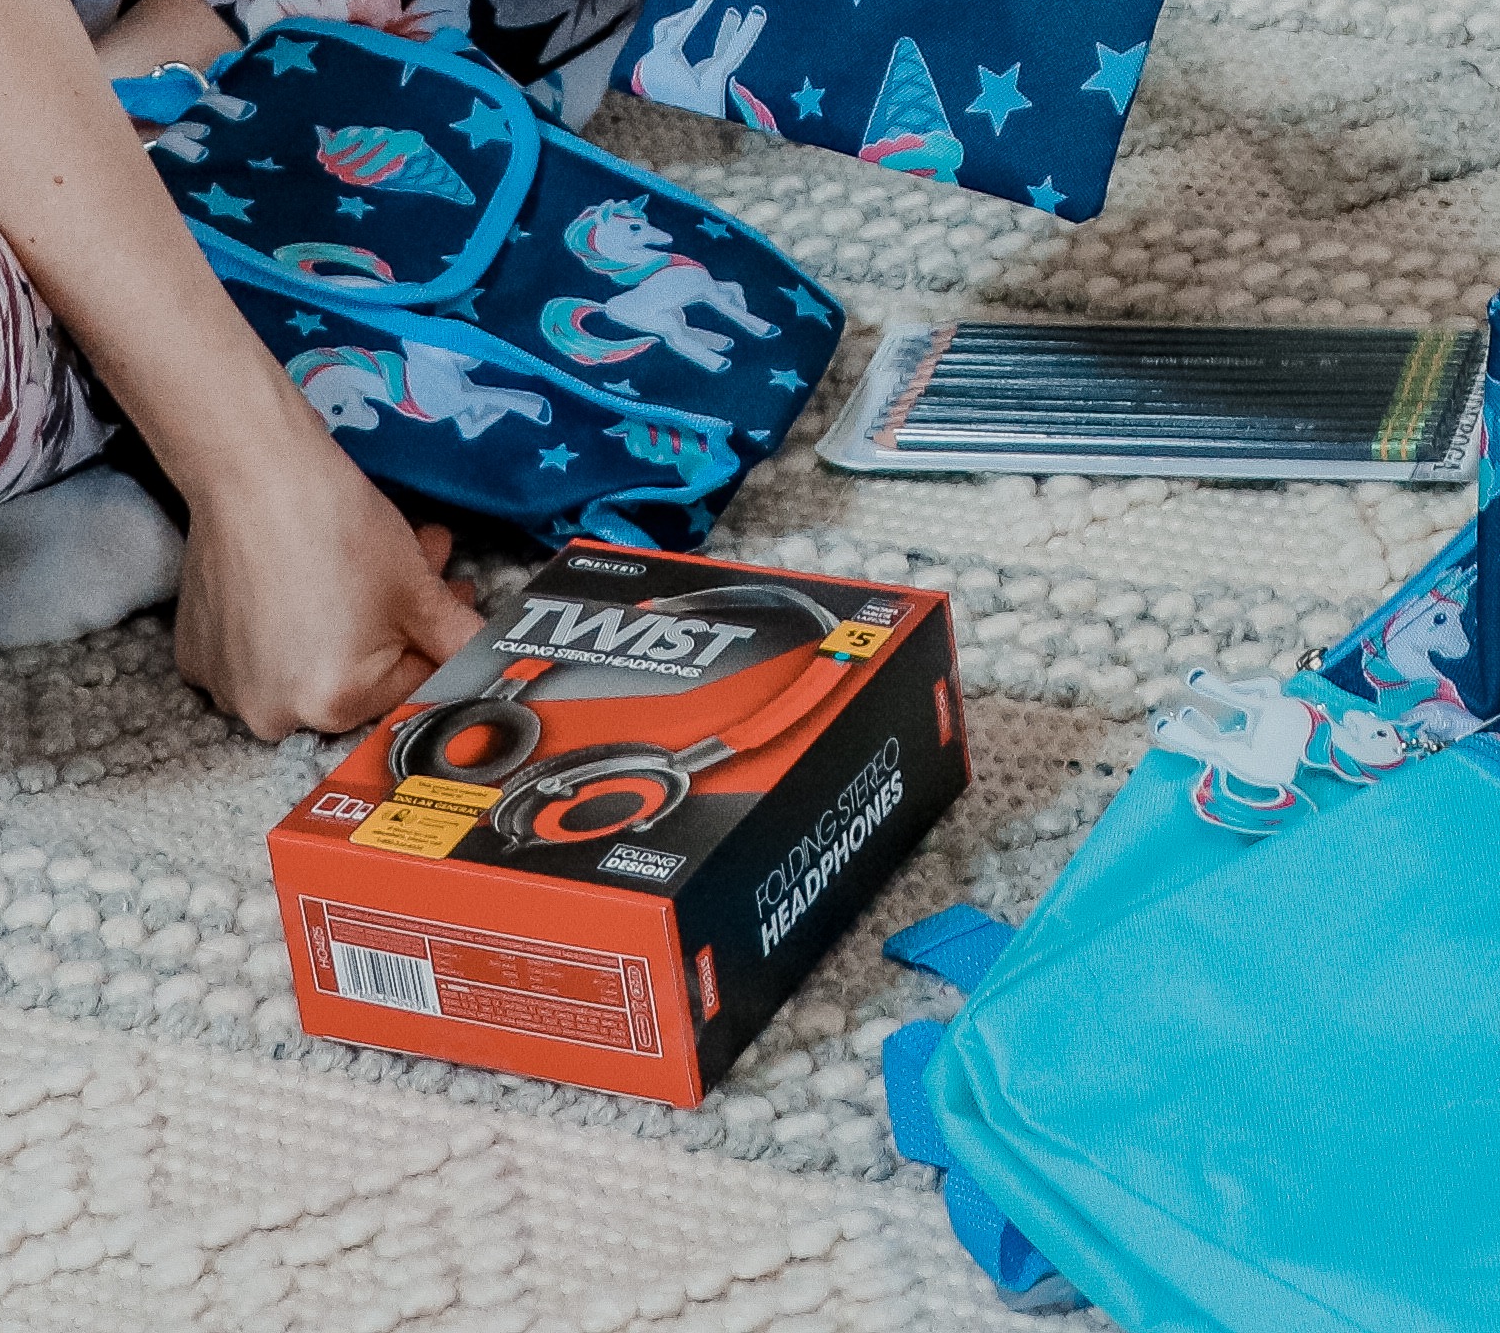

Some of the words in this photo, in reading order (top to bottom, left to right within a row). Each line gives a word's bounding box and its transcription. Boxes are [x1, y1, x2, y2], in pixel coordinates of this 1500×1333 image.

[505, 597, 757, 667] TWIST
[846, 629, 876, 647] $5
[492, 640, 554, 659] FOLDING
[553, 647, 606, 666] STEREO
[605, 654, 704, 679] HEADPHONES
[434, 800, 479, 817] GENERAL
[756, 809, 837, 918] FOLDING
[837, 736, 900, 826] STEREO
[603, 857, 672, 879] DESIGN
[613, 846, 677, 868] FOLDING
[761, 770, 904, 958] HEADPHONES
